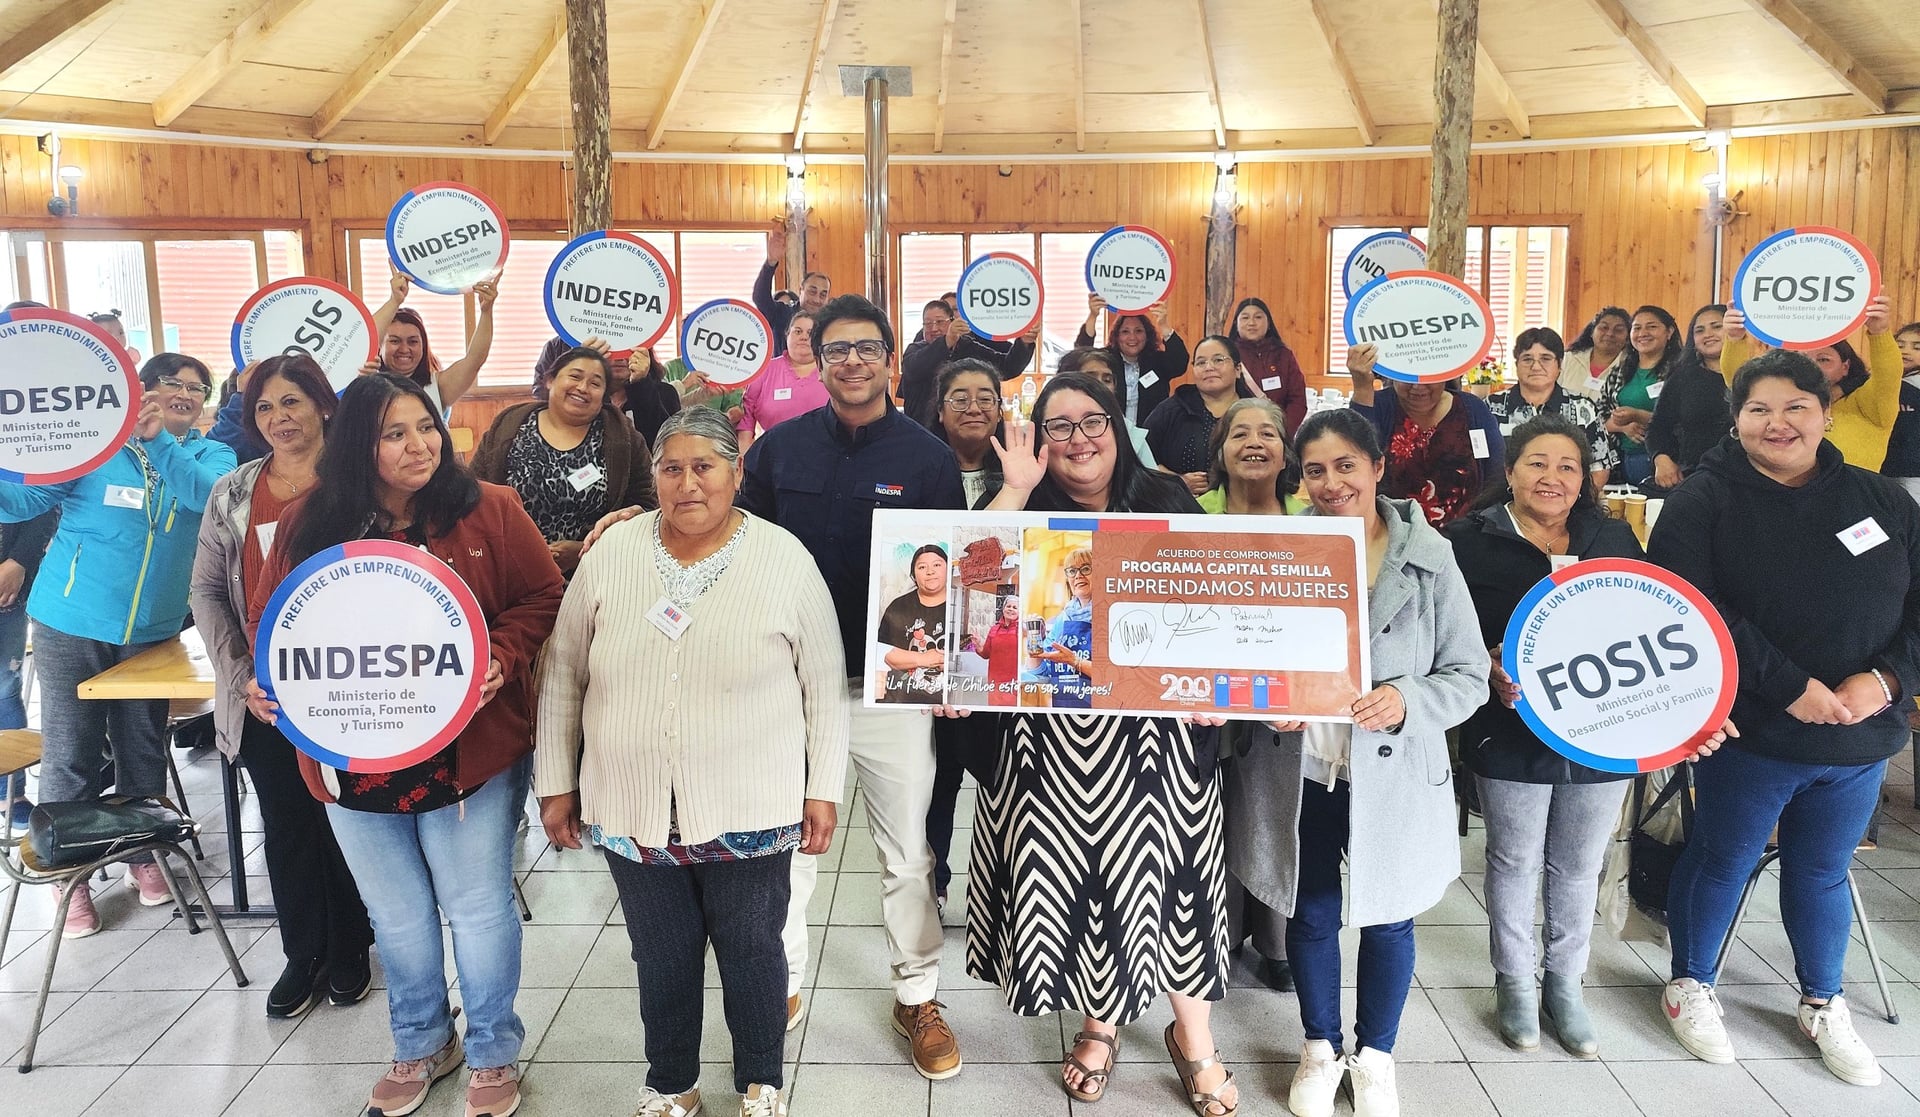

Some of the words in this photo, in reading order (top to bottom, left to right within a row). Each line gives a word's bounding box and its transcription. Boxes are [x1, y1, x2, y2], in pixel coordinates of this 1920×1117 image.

[397, 208, 412, 238] PREFIERE
[411, 199, 422, 209] UN
[422, 191, 486, 212] EMPRENDIMIENTO
[401, 219, 496, 264] INDESPA
[1369, 240, 1395, 250] PREFIERE
[434, 250, 470, 265] Ministerio
[462, 250, 492, 264] Fomento
[1752, 244, 1783, 273] PREFIERE
[1784, 239, 1797, 247] UN
[1800, 236, 1865, 274] EMPRENDIMIENTO
[563, 245, 593, 272] PREFIERE
[595, 242, 607, 250] UN
[610, 242, 665, 288] EMPRENDIMIENTO
[1094, 264, 1166, 282] INDESPA
[557, 280, 662, 314] INDESPA
[969, 288, 1031, 308] FOSIS
[1753, 276, 1856, 302] FOSIS
[248, 288, 319, 324] EMPRENDIMIENTO
[1357, 290, 1383, 318] PREFIERE
[1382, 283, 1394, 293] UN
[1396, 280, 1471, 305] EMPRENDIMIENTO
[570, 315, 609, 328] Economía,
[610, 322, 643, 332] Fomento
[583, 309, 622, 321] Ministerio
[697, 308, 719, 324] PREFIERE
[245, 326, 253, 337] UN
[594, 327, 624, 337] Turismo
[1359, 312, 1480, 342] INDESPA
[0, 326, 17, 339] UN
[21, 323, 118, 373] EMPRENDIMIENTO
[693, 327, 759, 361] FOSIS
[1385, 347, 1429, 359] Economía,
[1430, 342, 1467, 353] Fomento
[1396, 339, 1440, 350] Ministerio
[329, 346, 344, 365] Social
[1415, 353, 1449, 362] Turismo
[3, 420, 63, 432] Ministerio
[67, 419, 80, 428] de
[49, 429, 99, 440] Fomento
[16, 448, 22, 456] y
[25, 443, 72, 453] Turismo
[875, 487, 902, 496] INDESPA
[1156, 549, 1206, 559] ACUERDO
[1208, 550, 1221, 559] DE
[1223, 550, 1294, 560] COMPROMISO
[1121, 561, 1204, 574] PROGRAMA
[1207, 562, 1268, 576] CAPITAL
[1271, 564, 1331, 577] SEMILLA
[281, 576, 328, 630] PREFIERE
[329, 565, 350, 581] UN
[354, 562, 462, 628] EMPRENDIMIENTO
[1106, 578, 1254, 596] EMPRENDAMOS
[1260, 581, 1349, 599] MUJERES
[1523, 608, 1550, 664] PREFIERE
[1547, 591, 1566, 609] UN
[1568, 577, 1689, 616] EMPRENDIMIENTO
[279, 643, 464, 681] INDESPA
[1536, 624, 1698, 711] FOSIS
[328, 689, 396, 701] Ministerio
[400, 689, 416, 699] de
[961, 676, 995, 692] Chiloé
[1024, 684, 1038, 693] en
[1041, 683, 1059, 694] sus
[1063, 682, 1113, 700] mujeres!
[1160, 674, 1212, 700] 200
[1596, 688, 1654, 714] Ministerio
[1656, 682, 1671, 694] de
[308, 705, 375, 717] Economía,
[379, 705, 436, 715] Fomento
[1568, 714, 1625, 739] Desarrollo
[1626, 703, 1661, 720] Social
[1662, 701, 1670, 711] y
[1671, 685, 1714, 706] Familia
[341, 722, 348, 733] y
[352, 719, 404, 731] Turismo
